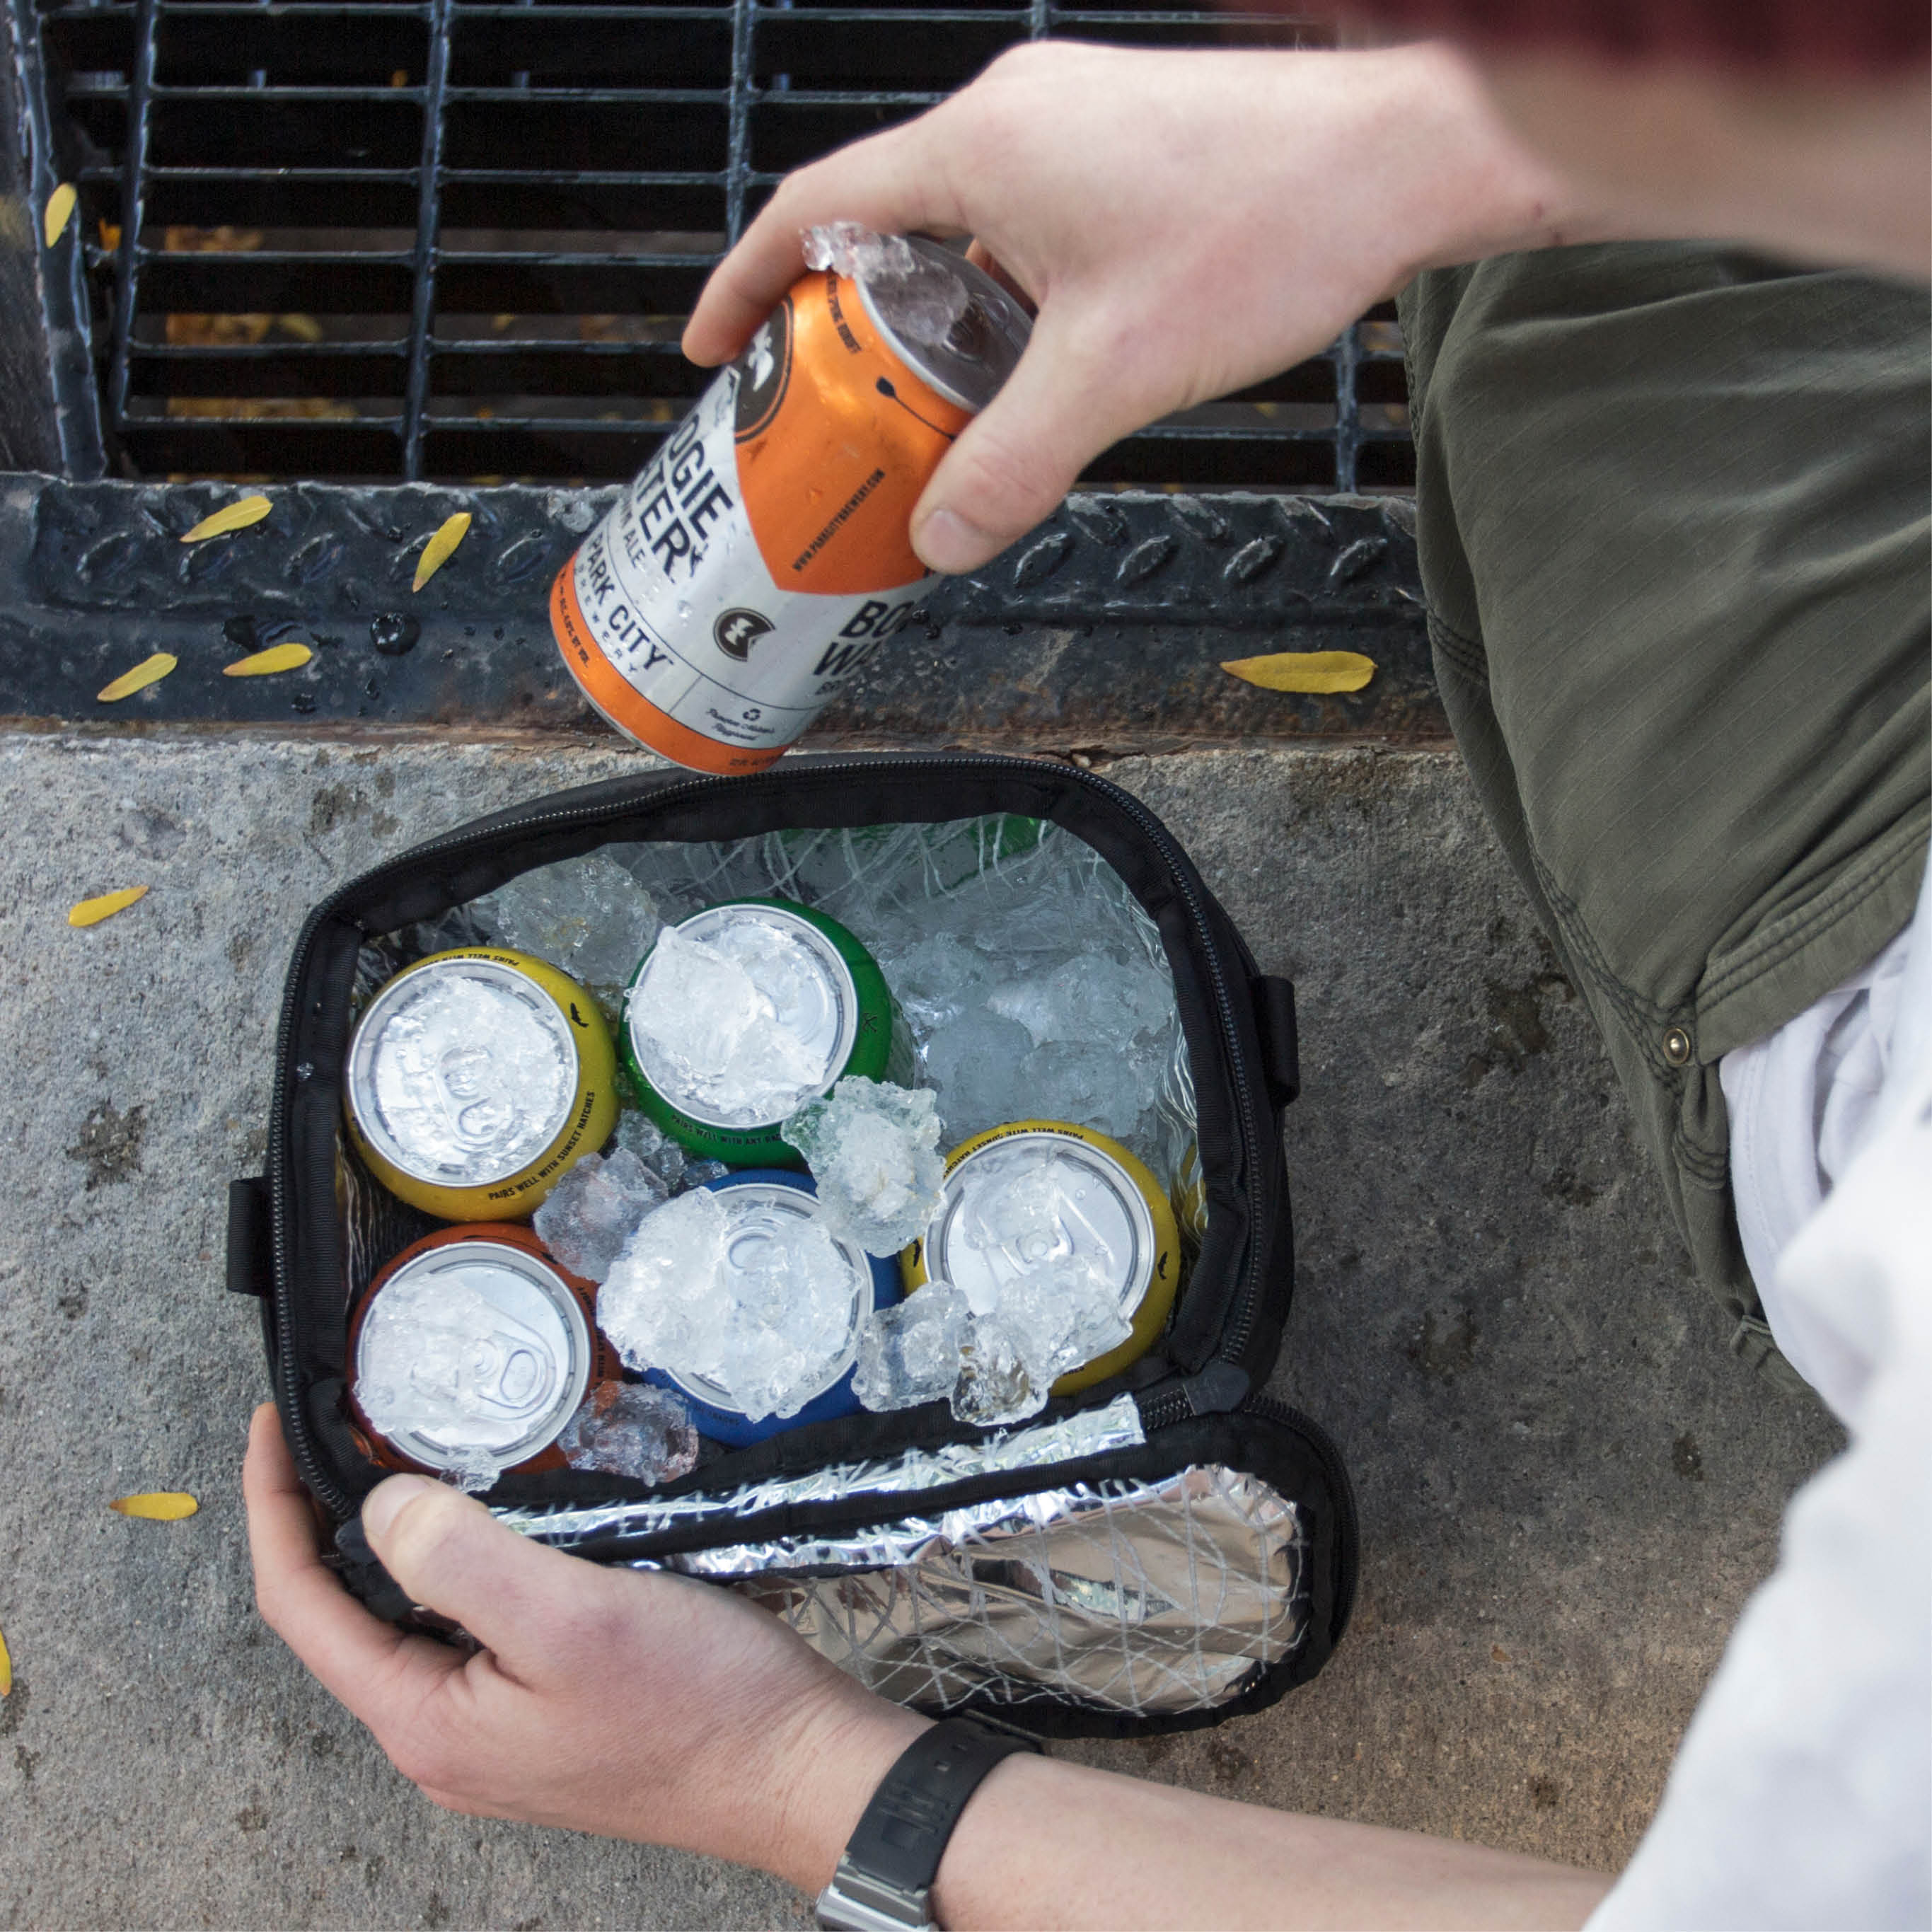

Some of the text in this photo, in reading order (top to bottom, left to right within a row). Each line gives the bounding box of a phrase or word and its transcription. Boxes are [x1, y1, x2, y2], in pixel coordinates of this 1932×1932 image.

[623, 528, 646, 569] ALE
[588, 531, 667, 670] PARK CITY
[492, 956, 520, 967] PAIRS
[488, 1092, 595, 1201] PAIRS WELL WITH SUNSET HATCHES
[720, 1135, 743, 1145] WITH
[1058, 1129, 1084, 1140] PAIRS
